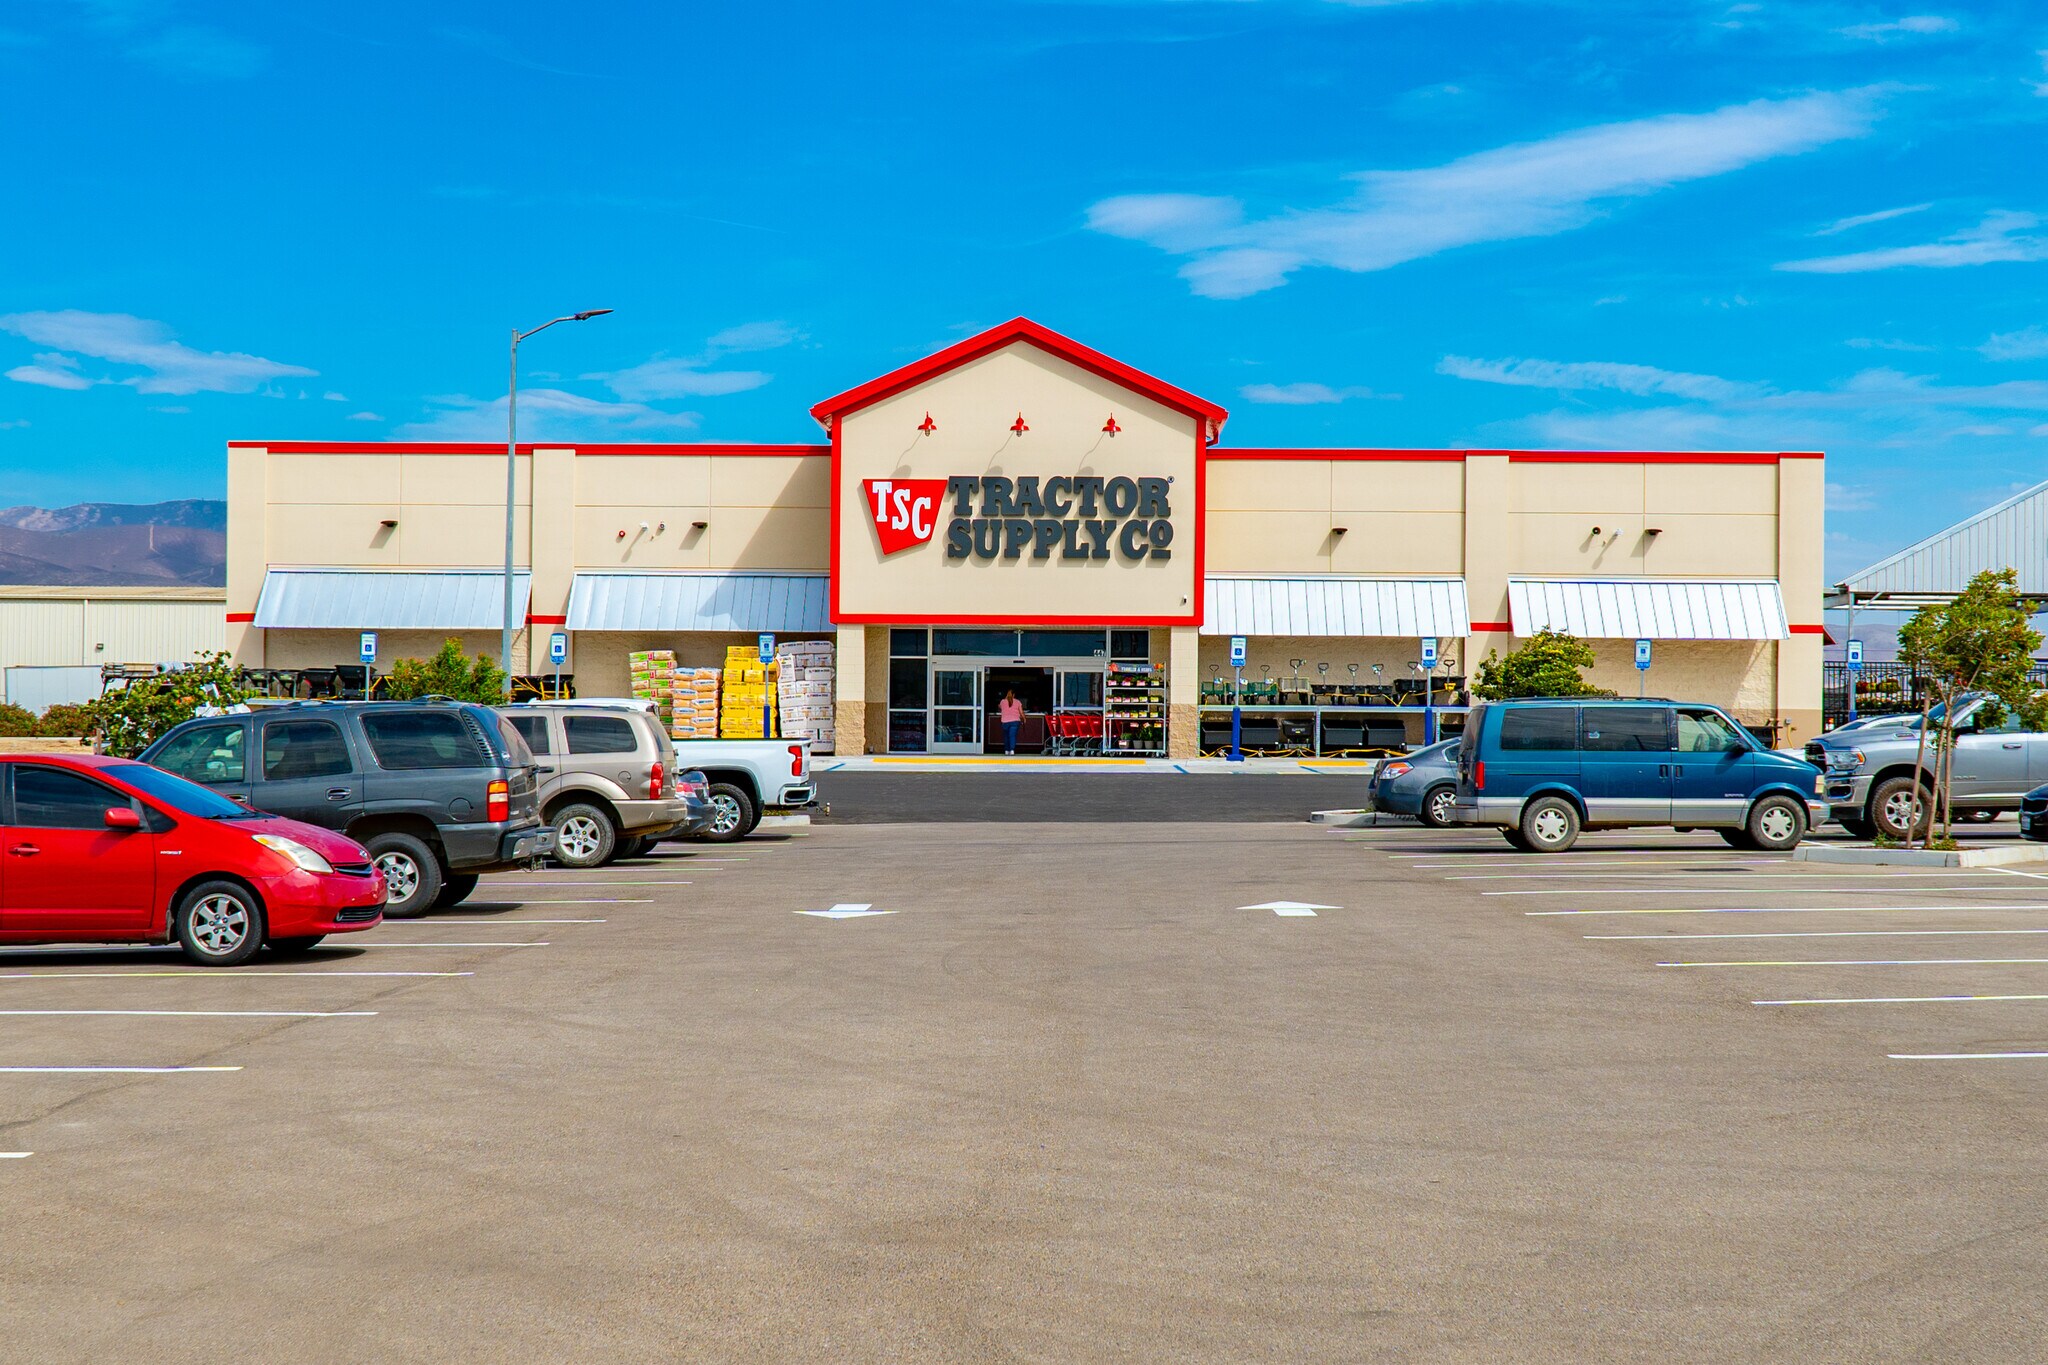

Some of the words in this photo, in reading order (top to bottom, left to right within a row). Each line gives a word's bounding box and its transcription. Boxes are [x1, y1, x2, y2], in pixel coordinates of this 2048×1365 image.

[872, 481, 931, 540] TSC
[949, 476, 1171, 517] TRACTOR
[948, 518, 1117, 559] SUPPLY
